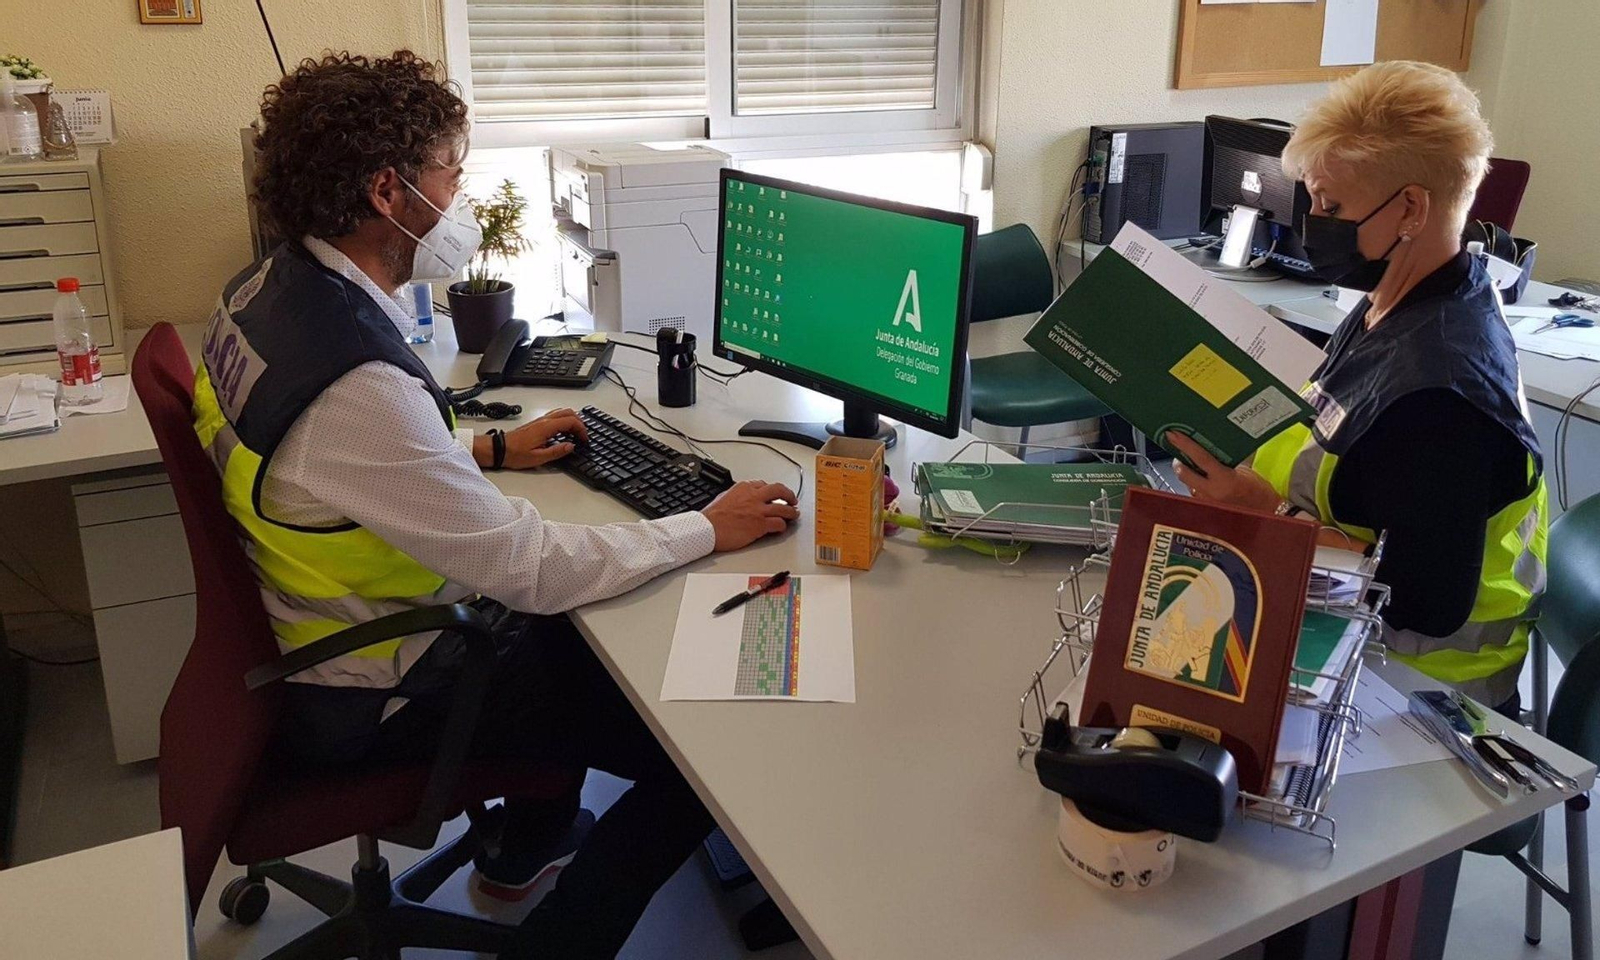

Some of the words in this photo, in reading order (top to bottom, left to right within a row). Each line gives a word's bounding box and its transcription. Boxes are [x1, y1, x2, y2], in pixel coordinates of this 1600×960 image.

[875, 328, 895, 344] Junta
[895, 334, 905, 347] de
[905, 337, 939, 357] Andalucía
[1047, 330, 1084, 360] ANDALUCIA
[876, 346, 905, 364] Delegación
[905, 355, 915, 367] del
[914, 358, 940, 375] Gobierno
[1082, 357, 1095, 368] DE
[894, 367, 917, 384] Granada
[1094, 365, 1117, 384] JUNTA
[1176, 535, 1210, 550] Unidad
[1211, 544, 1224, 553] de
[1144, 530, 1172, 601] ANDALUCIA
[1139, 603, 1156, 621] DE
[1130, 626, 1151, 668] JUNTA
[1137, 709, 1169, 724] UNIDAD
[1170, 719, 1182, 728] DE
